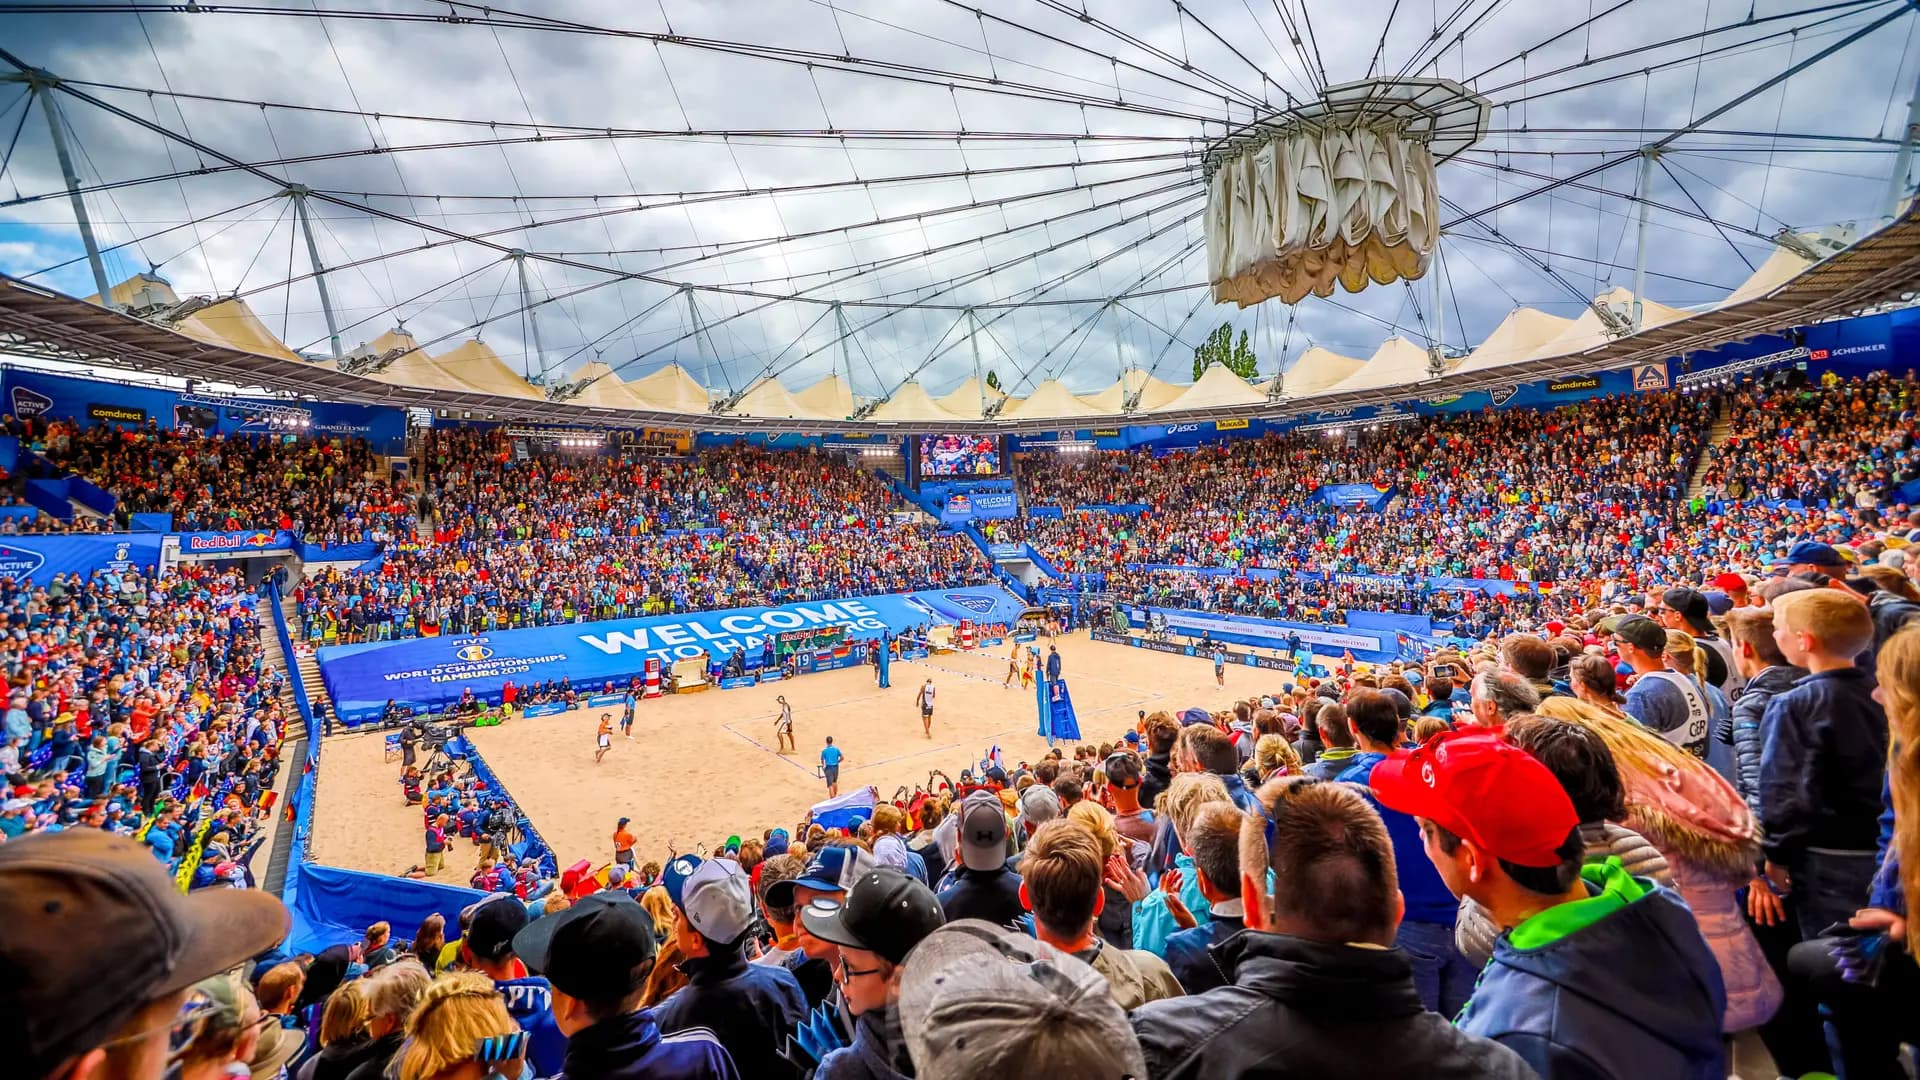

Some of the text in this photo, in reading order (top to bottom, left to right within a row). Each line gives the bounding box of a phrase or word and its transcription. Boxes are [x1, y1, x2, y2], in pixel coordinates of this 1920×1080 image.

[1832, 344, 1886, 356] SCHENKER
[1552, 379, 1597, 390] comdirect
[17, 401, 45, 409] ACTIVE
[93, 408, 142, 420] comdirect
[976, 496, 1011, 505] WELCOME
[192, 535, 240, 549] Red Bull
[578, 601, 878, 654] WELCOME
[453, 637, 489, 646] FIVB
[781, 632, 800, 641] Red
[1152, 642, 1177, 653] Techniker
[646, 645, 704, 663] TO
[796, 654, 808, 666] 19
[855, 646, 866, 657] 19
[384, 654, 567, 681] WORLD CHAMPIONSHIPS
[1258, 659, 1269, 667] Die
[430, 665, 530, 683] HAMBURG 2019
[1690, 719, 1706, 737] GER
